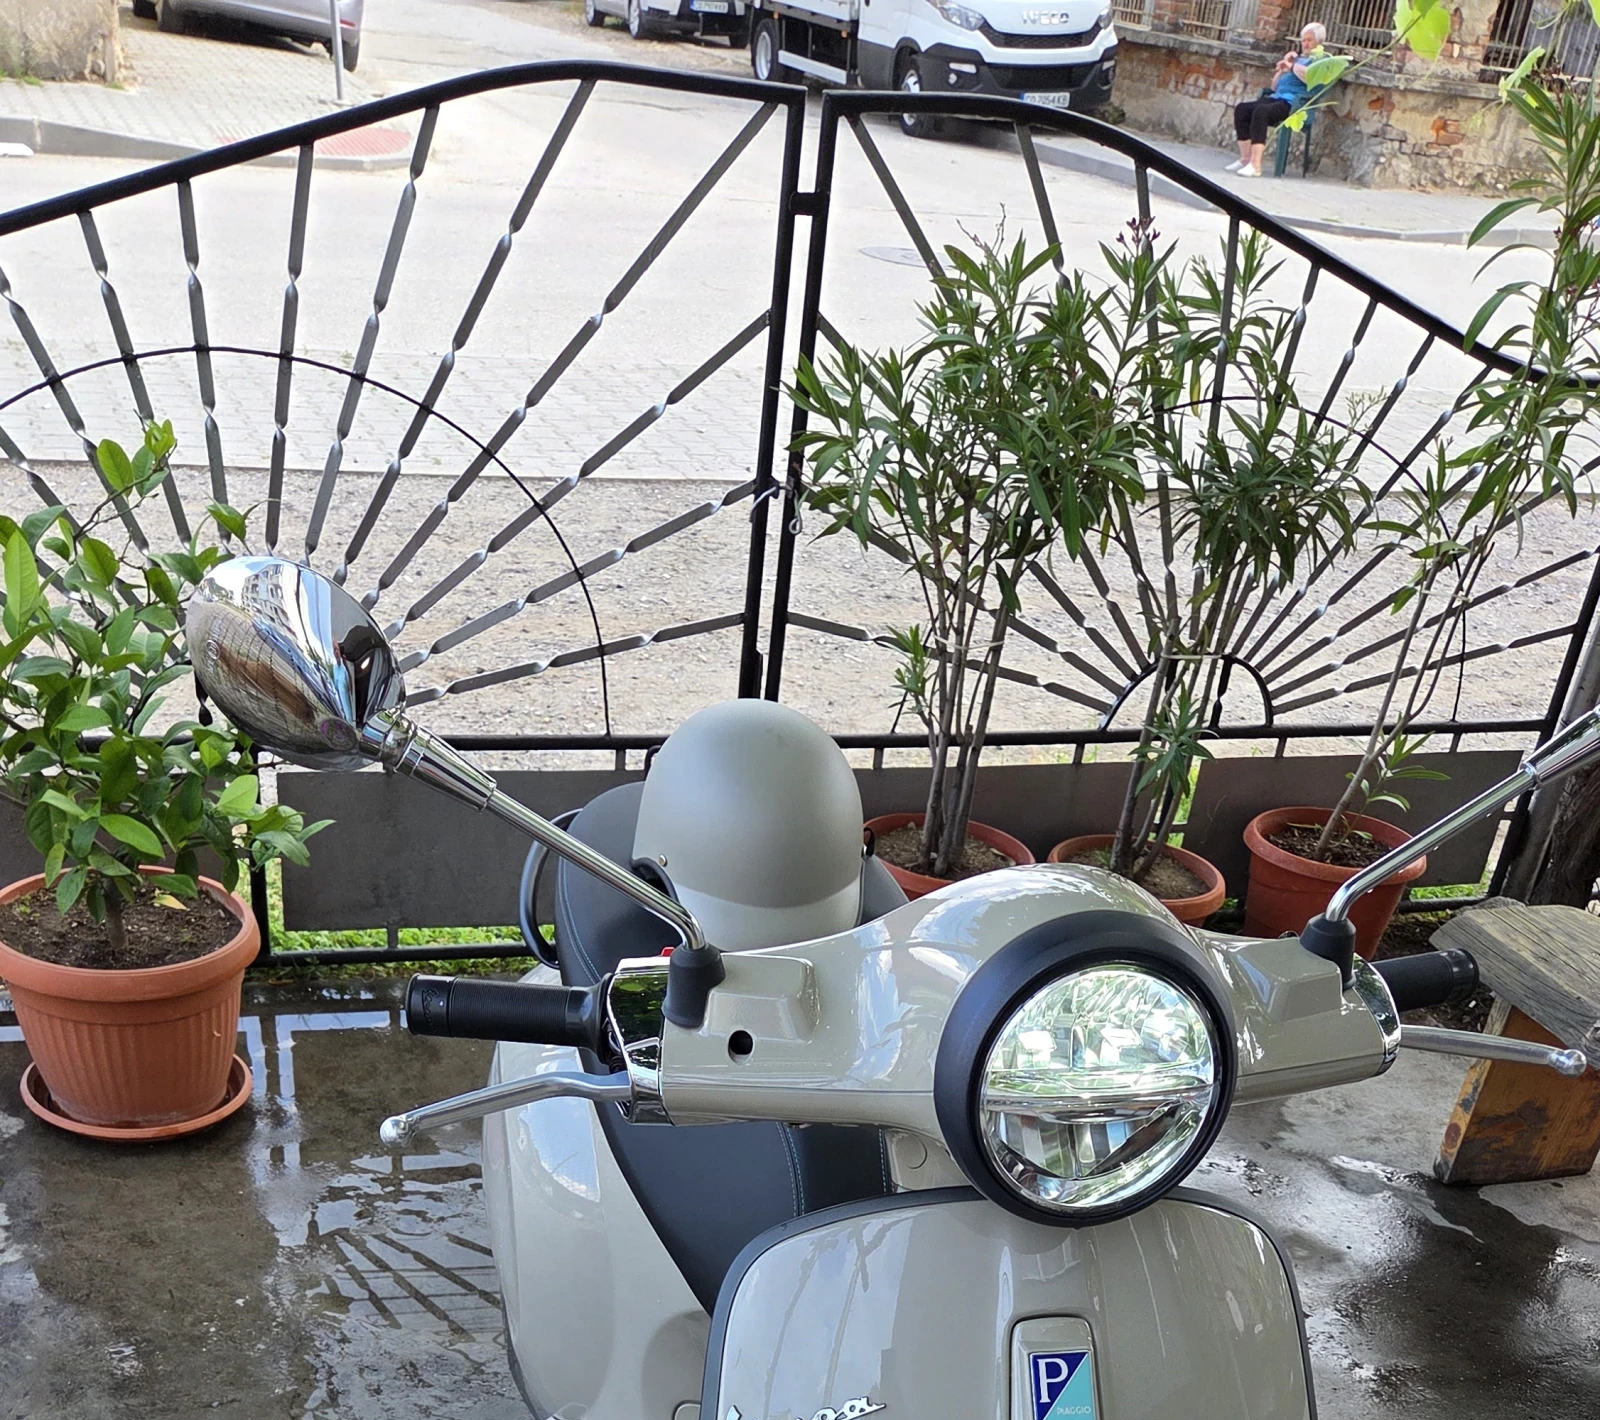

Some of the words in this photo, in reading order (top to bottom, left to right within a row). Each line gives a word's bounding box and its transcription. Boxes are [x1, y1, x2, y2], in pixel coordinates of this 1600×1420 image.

[1022, 10, 1070, 25] IVECO
[1036, 1357, 1069, 1404] P
[1056, 1405, 1092, 1416] PIAGGIO
